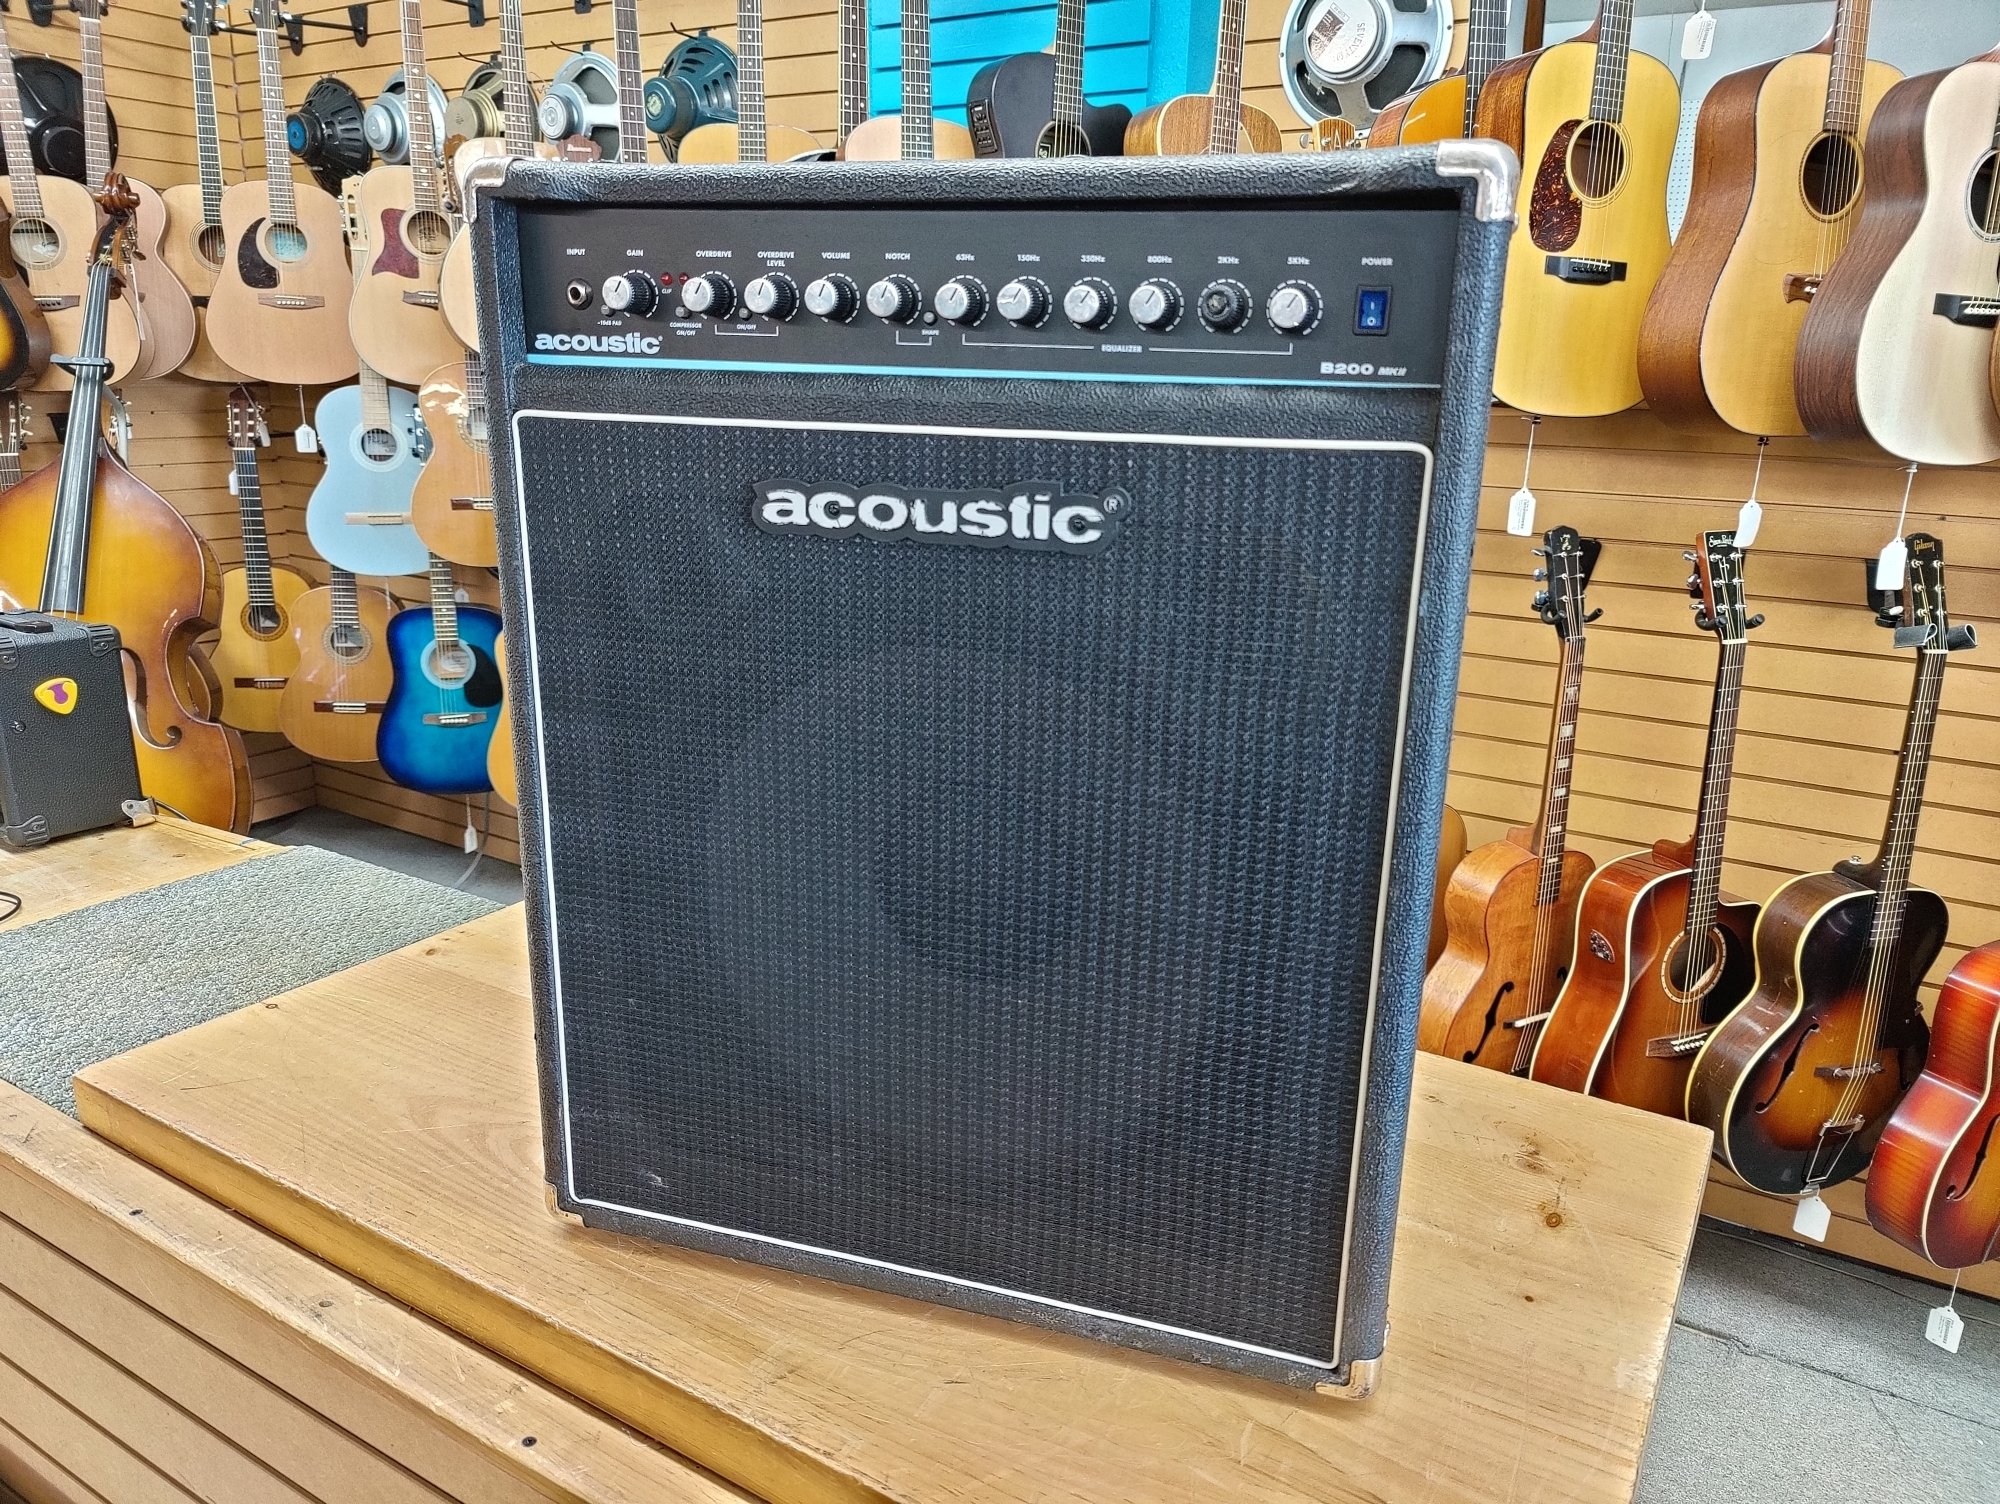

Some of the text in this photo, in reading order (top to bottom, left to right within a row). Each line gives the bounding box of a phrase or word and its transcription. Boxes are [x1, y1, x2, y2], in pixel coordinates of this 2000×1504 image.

[566, 248, 586, 256] INPUT
[626, 249, 644, 257] GAIN
[695, 250, 732, 258] OVERDRIVE
[757, 251, 795, 259] OVERDRIVE
[821, 252, 851, 260] VOLUME
[885, 252, 911, 260] NOTCH
[955, 253, 975, 261] 63Hz
[1017, 254, 1040, 262] 150Hz
[1080, 254, 1106, 263] 350Hz
[1147, 255, 1173, 264] 800Hz
[1217, 256, 1240, 265] 2KHz
[1361, 257, 1393, 266] POWER
[1101, 344, 1142, 353] EQUALIZER
[1320, 361, 1374, 375] B200
